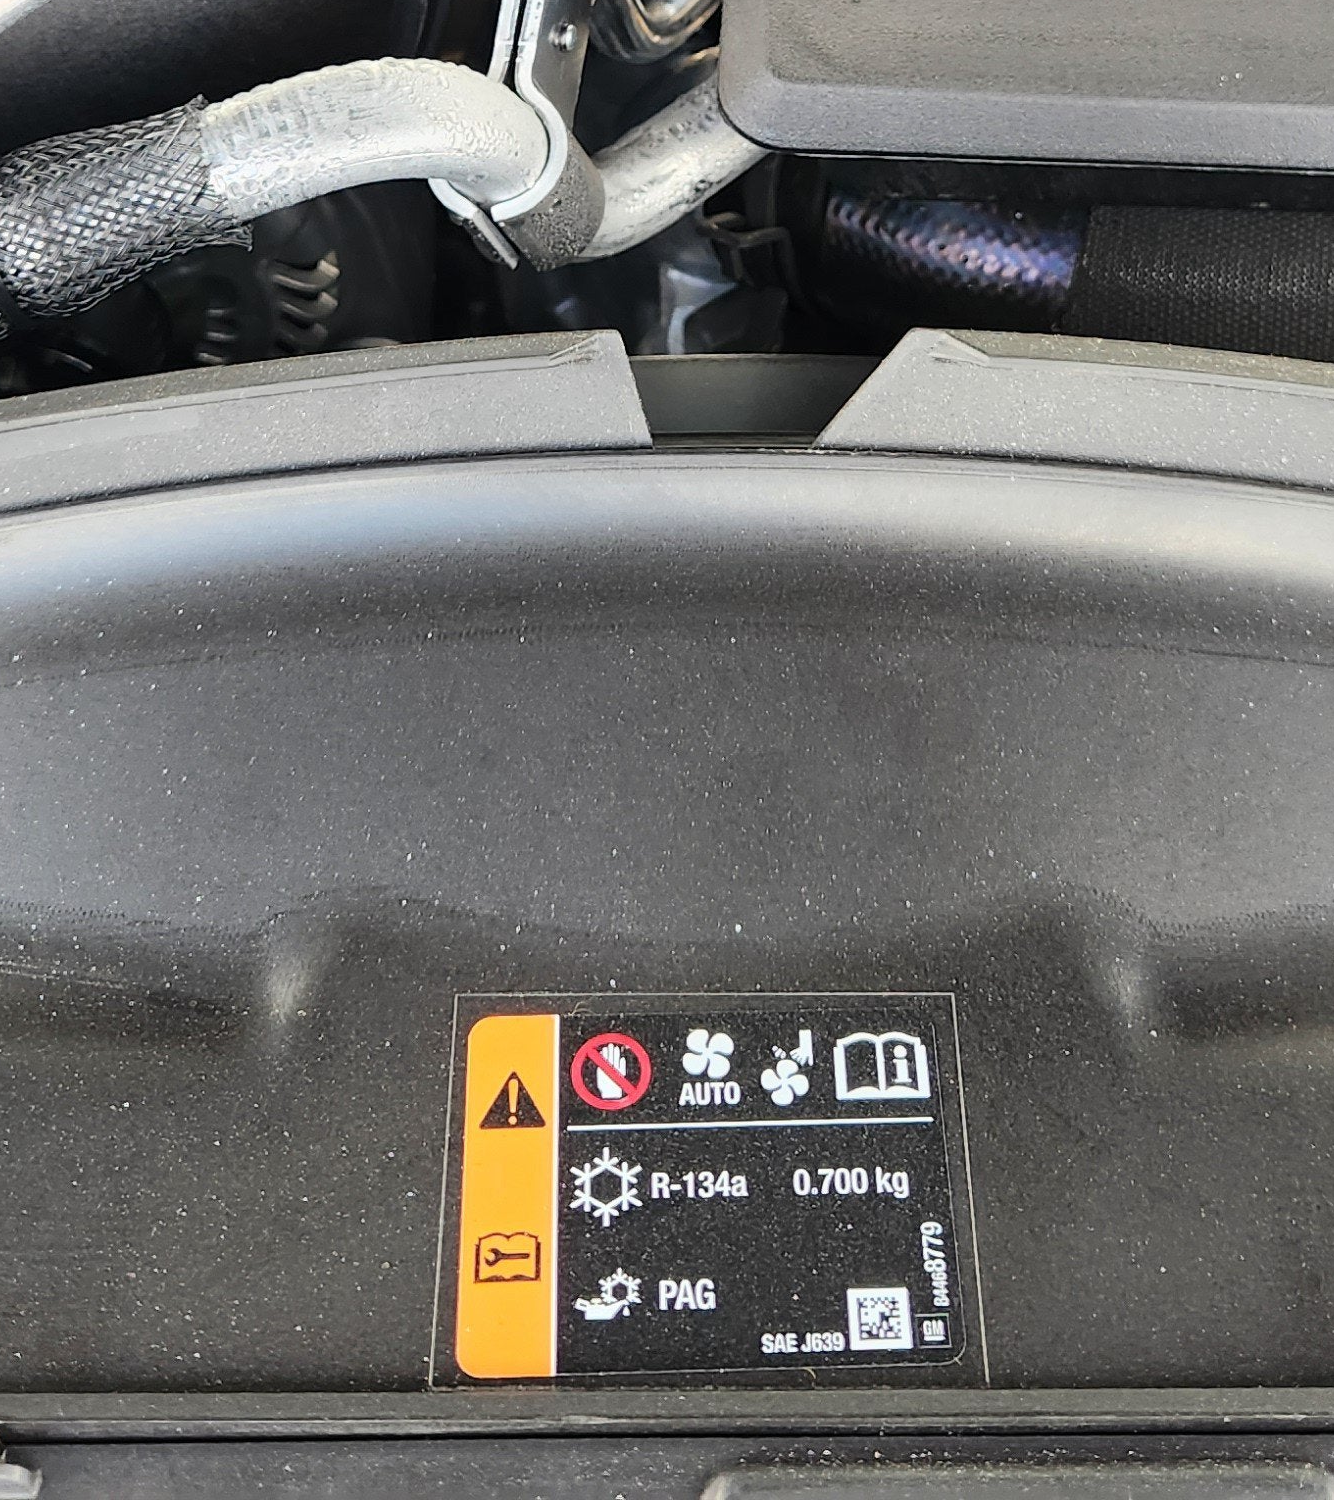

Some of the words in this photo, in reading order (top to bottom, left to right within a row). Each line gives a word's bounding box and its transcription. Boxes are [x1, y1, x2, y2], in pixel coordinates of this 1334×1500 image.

[678, 1081, 741, 1106] AUTO
[650, 1170, 749, 1199] R-134a
[793, 1168, 868, 1196] 0.700
[875, 1166, 910, 1199] kg
[658, 1278, 717, 1311] PAG
[922, 1319, 946, 1335] GM
[760, 1332, 800, 1354] SAE
[800, 1331, 846, 1353] J639
